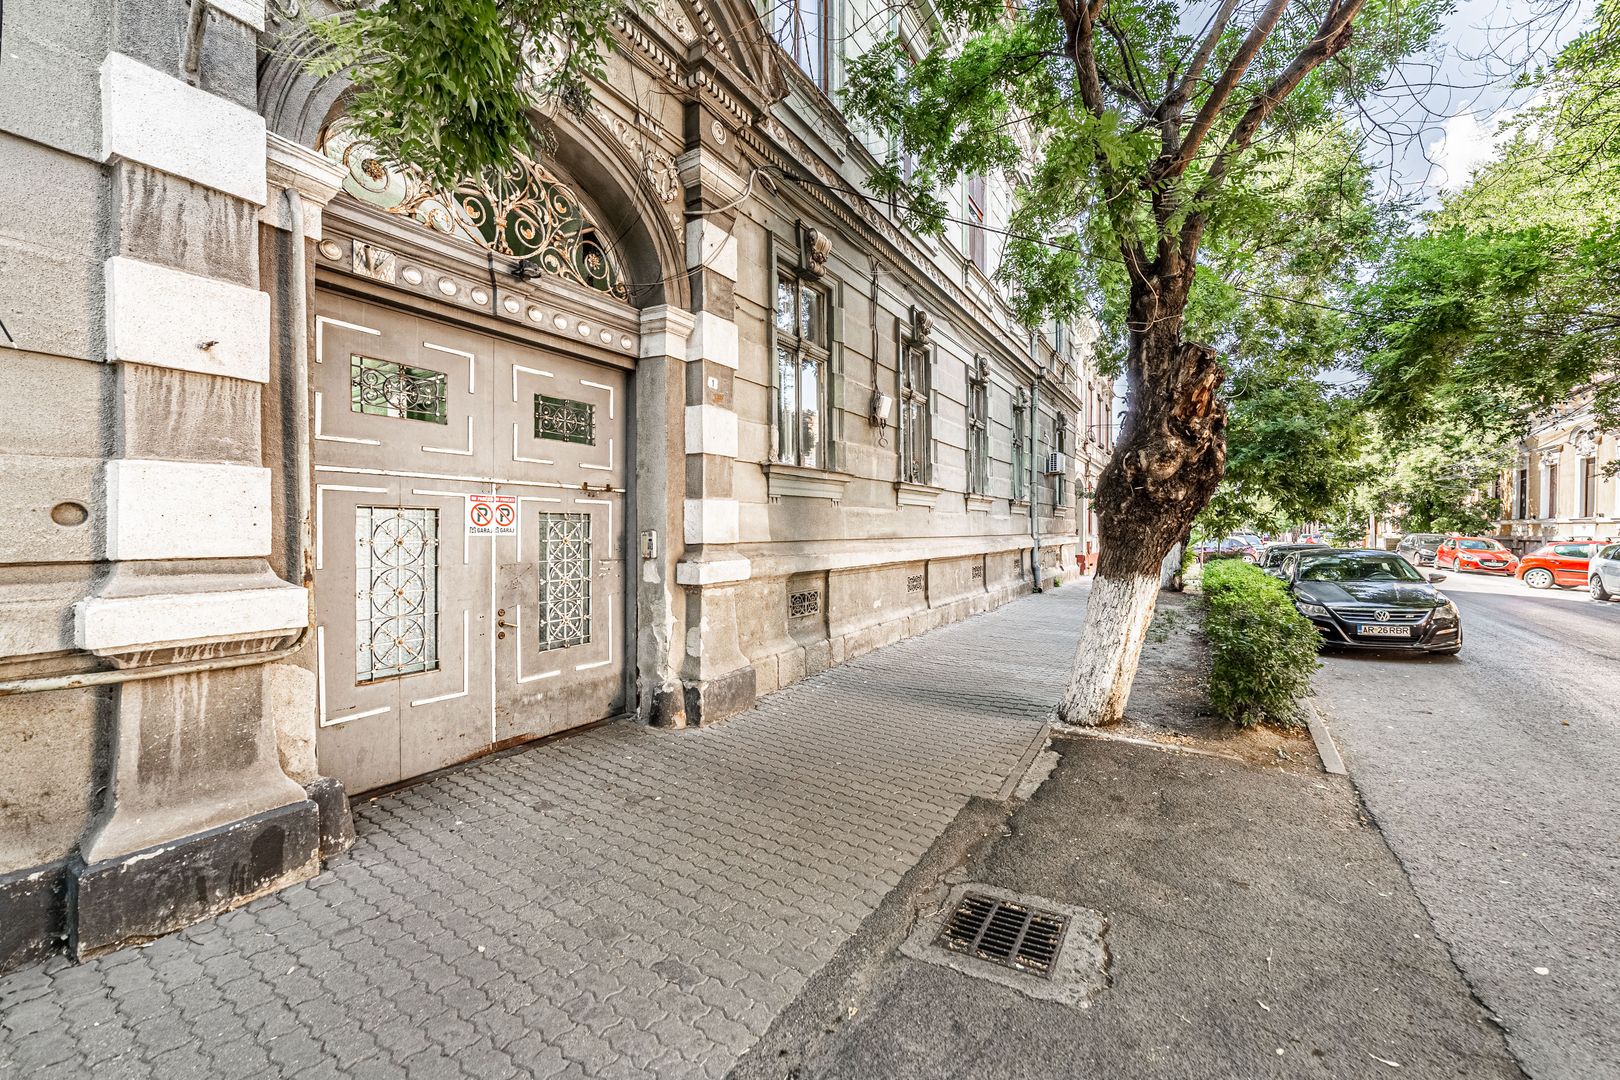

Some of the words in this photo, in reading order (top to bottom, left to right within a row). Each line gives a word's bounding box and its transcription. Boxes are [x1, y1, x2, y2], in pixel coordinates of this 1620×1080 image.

[1363, 626, 1375, 634] AR
[1377, 626, 1389, 634] 26
[1389, 627, 1409, 635] RBR
